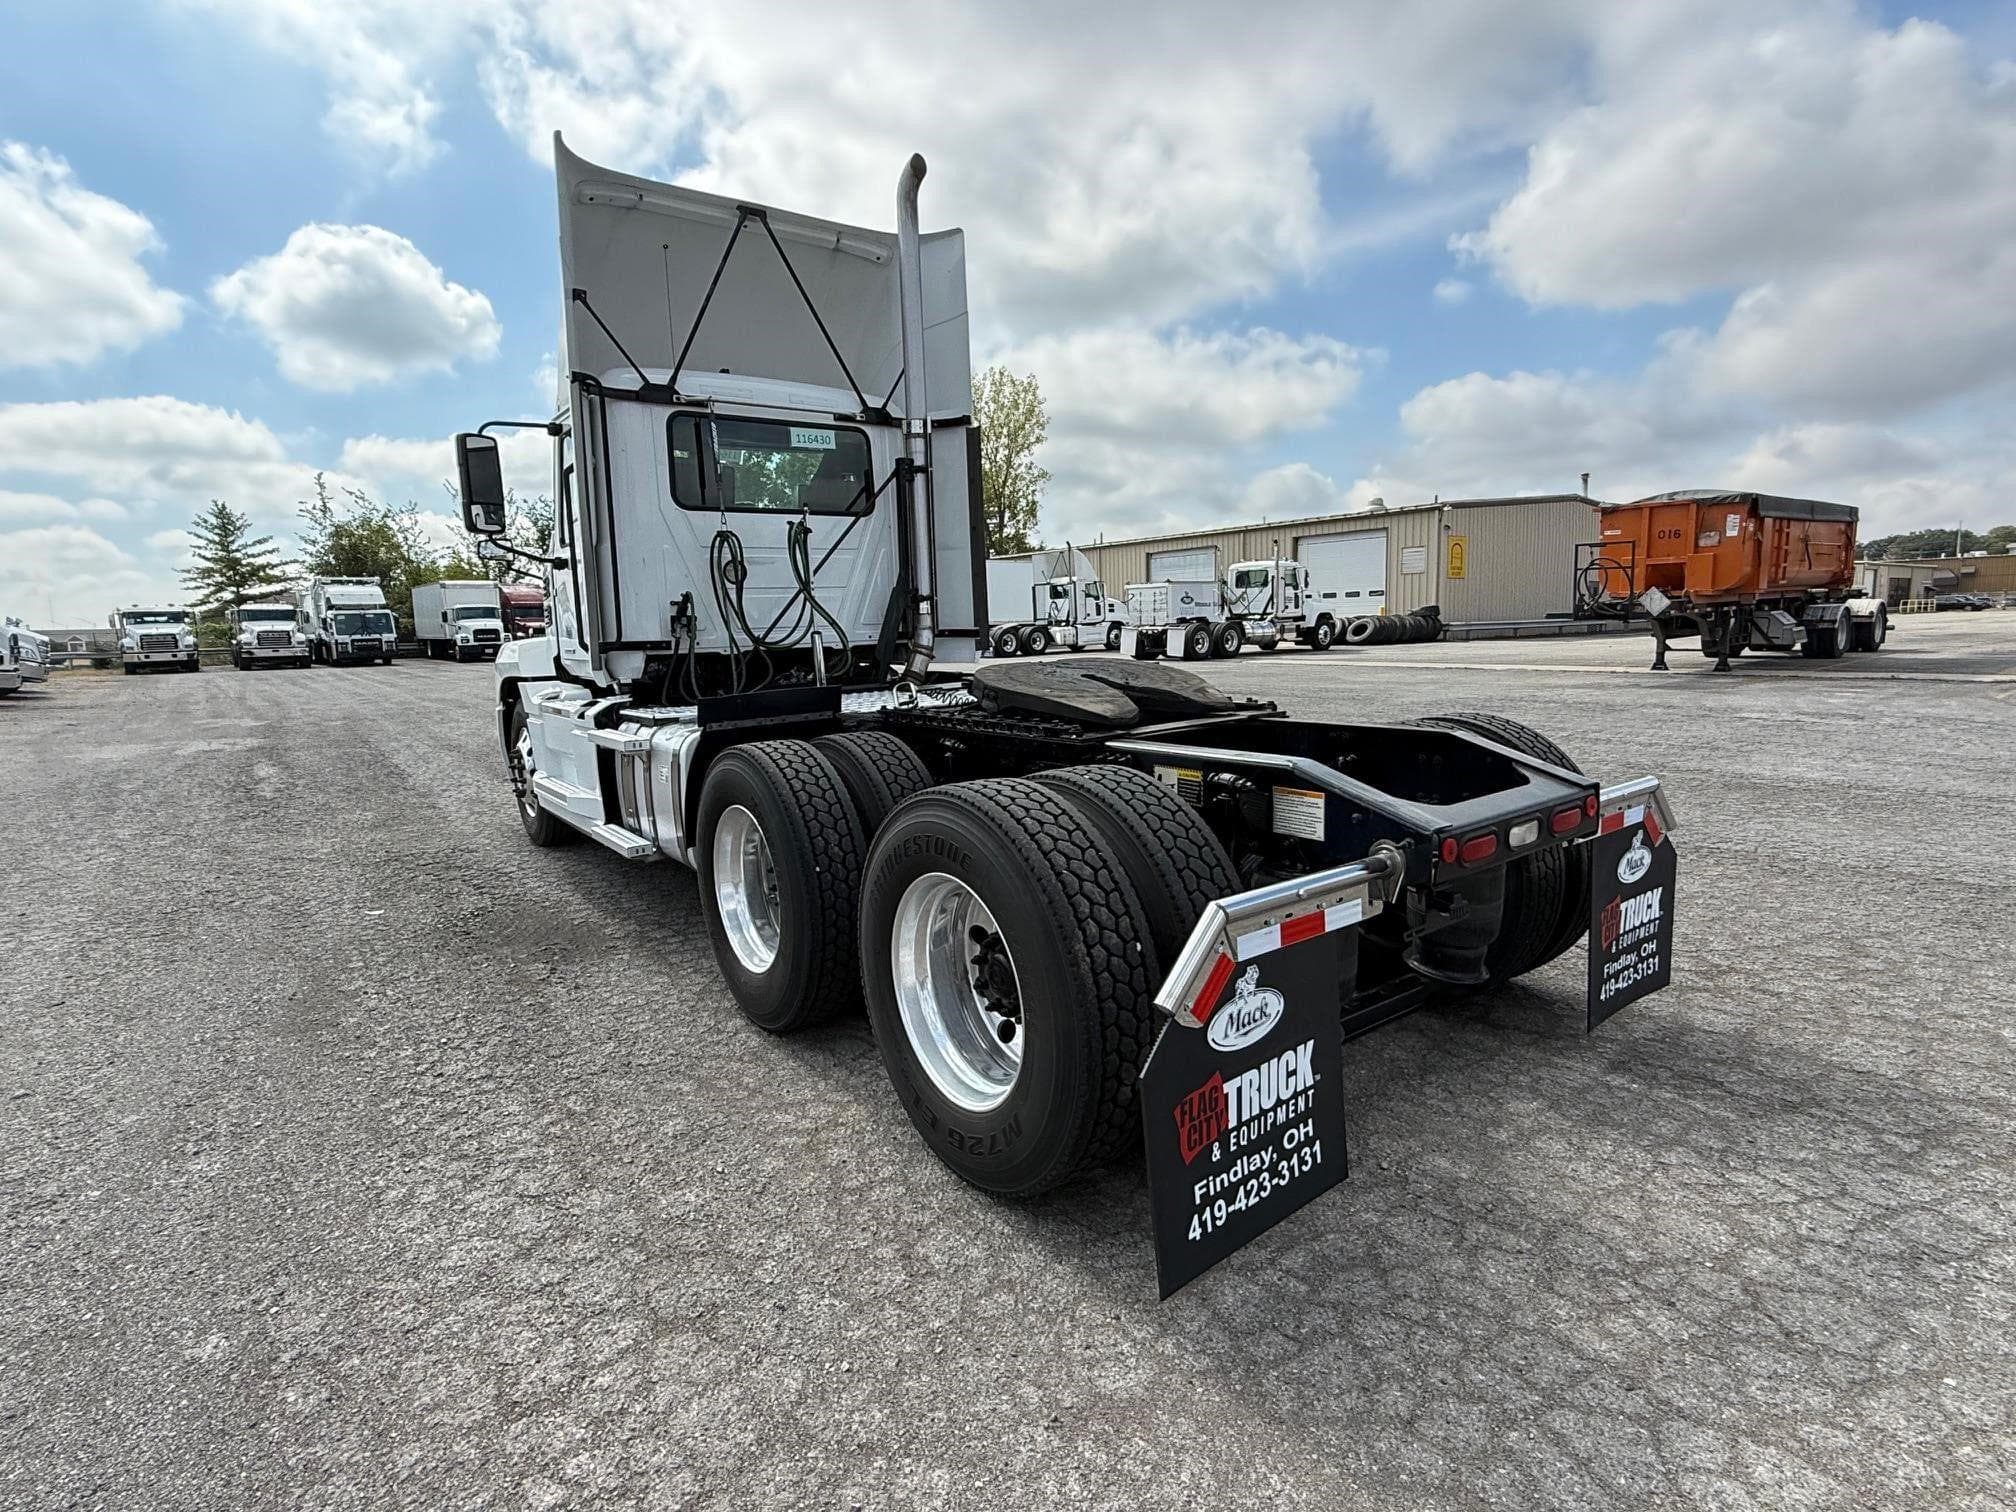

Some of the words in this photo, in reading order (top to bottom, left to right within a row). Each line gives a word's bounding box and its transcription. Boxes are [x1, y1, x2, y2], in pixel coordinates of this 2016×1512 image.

[795, 433, 831, 446] 116430
[1658, 527, 1682, 541] 016
[871, 833, 973, 900] IDGESTONE
[1623, 854, 1645, 873] Mack
[1619, 886, 1663, 935] TRUCK
[1619, 920, 1660, 951] EQUIPMENT
[1600, 955, 1660, 1002] 419-423-3131
[1604, 951, 1639, 979] Findlay,
[1641, 940, 1657, 959] OH
[1223, 996, 1270, 1039] Mack
[1178, 1083, 1222, 1128] FLAG
[1223, 1038, 1316, 1129] TRUCK
[1186, 1110, 1228, 1153] CITY
[1211, 1141, 1222, 1163] &
[1229, 1088, 1315, 1152] EQUIPMENT
[1194, 1148, 1278, 1206] Findlay,
[1282, 1117, 1314, 1147] OH
[1187, 1139, 1323, 1242] 419-423-3131
